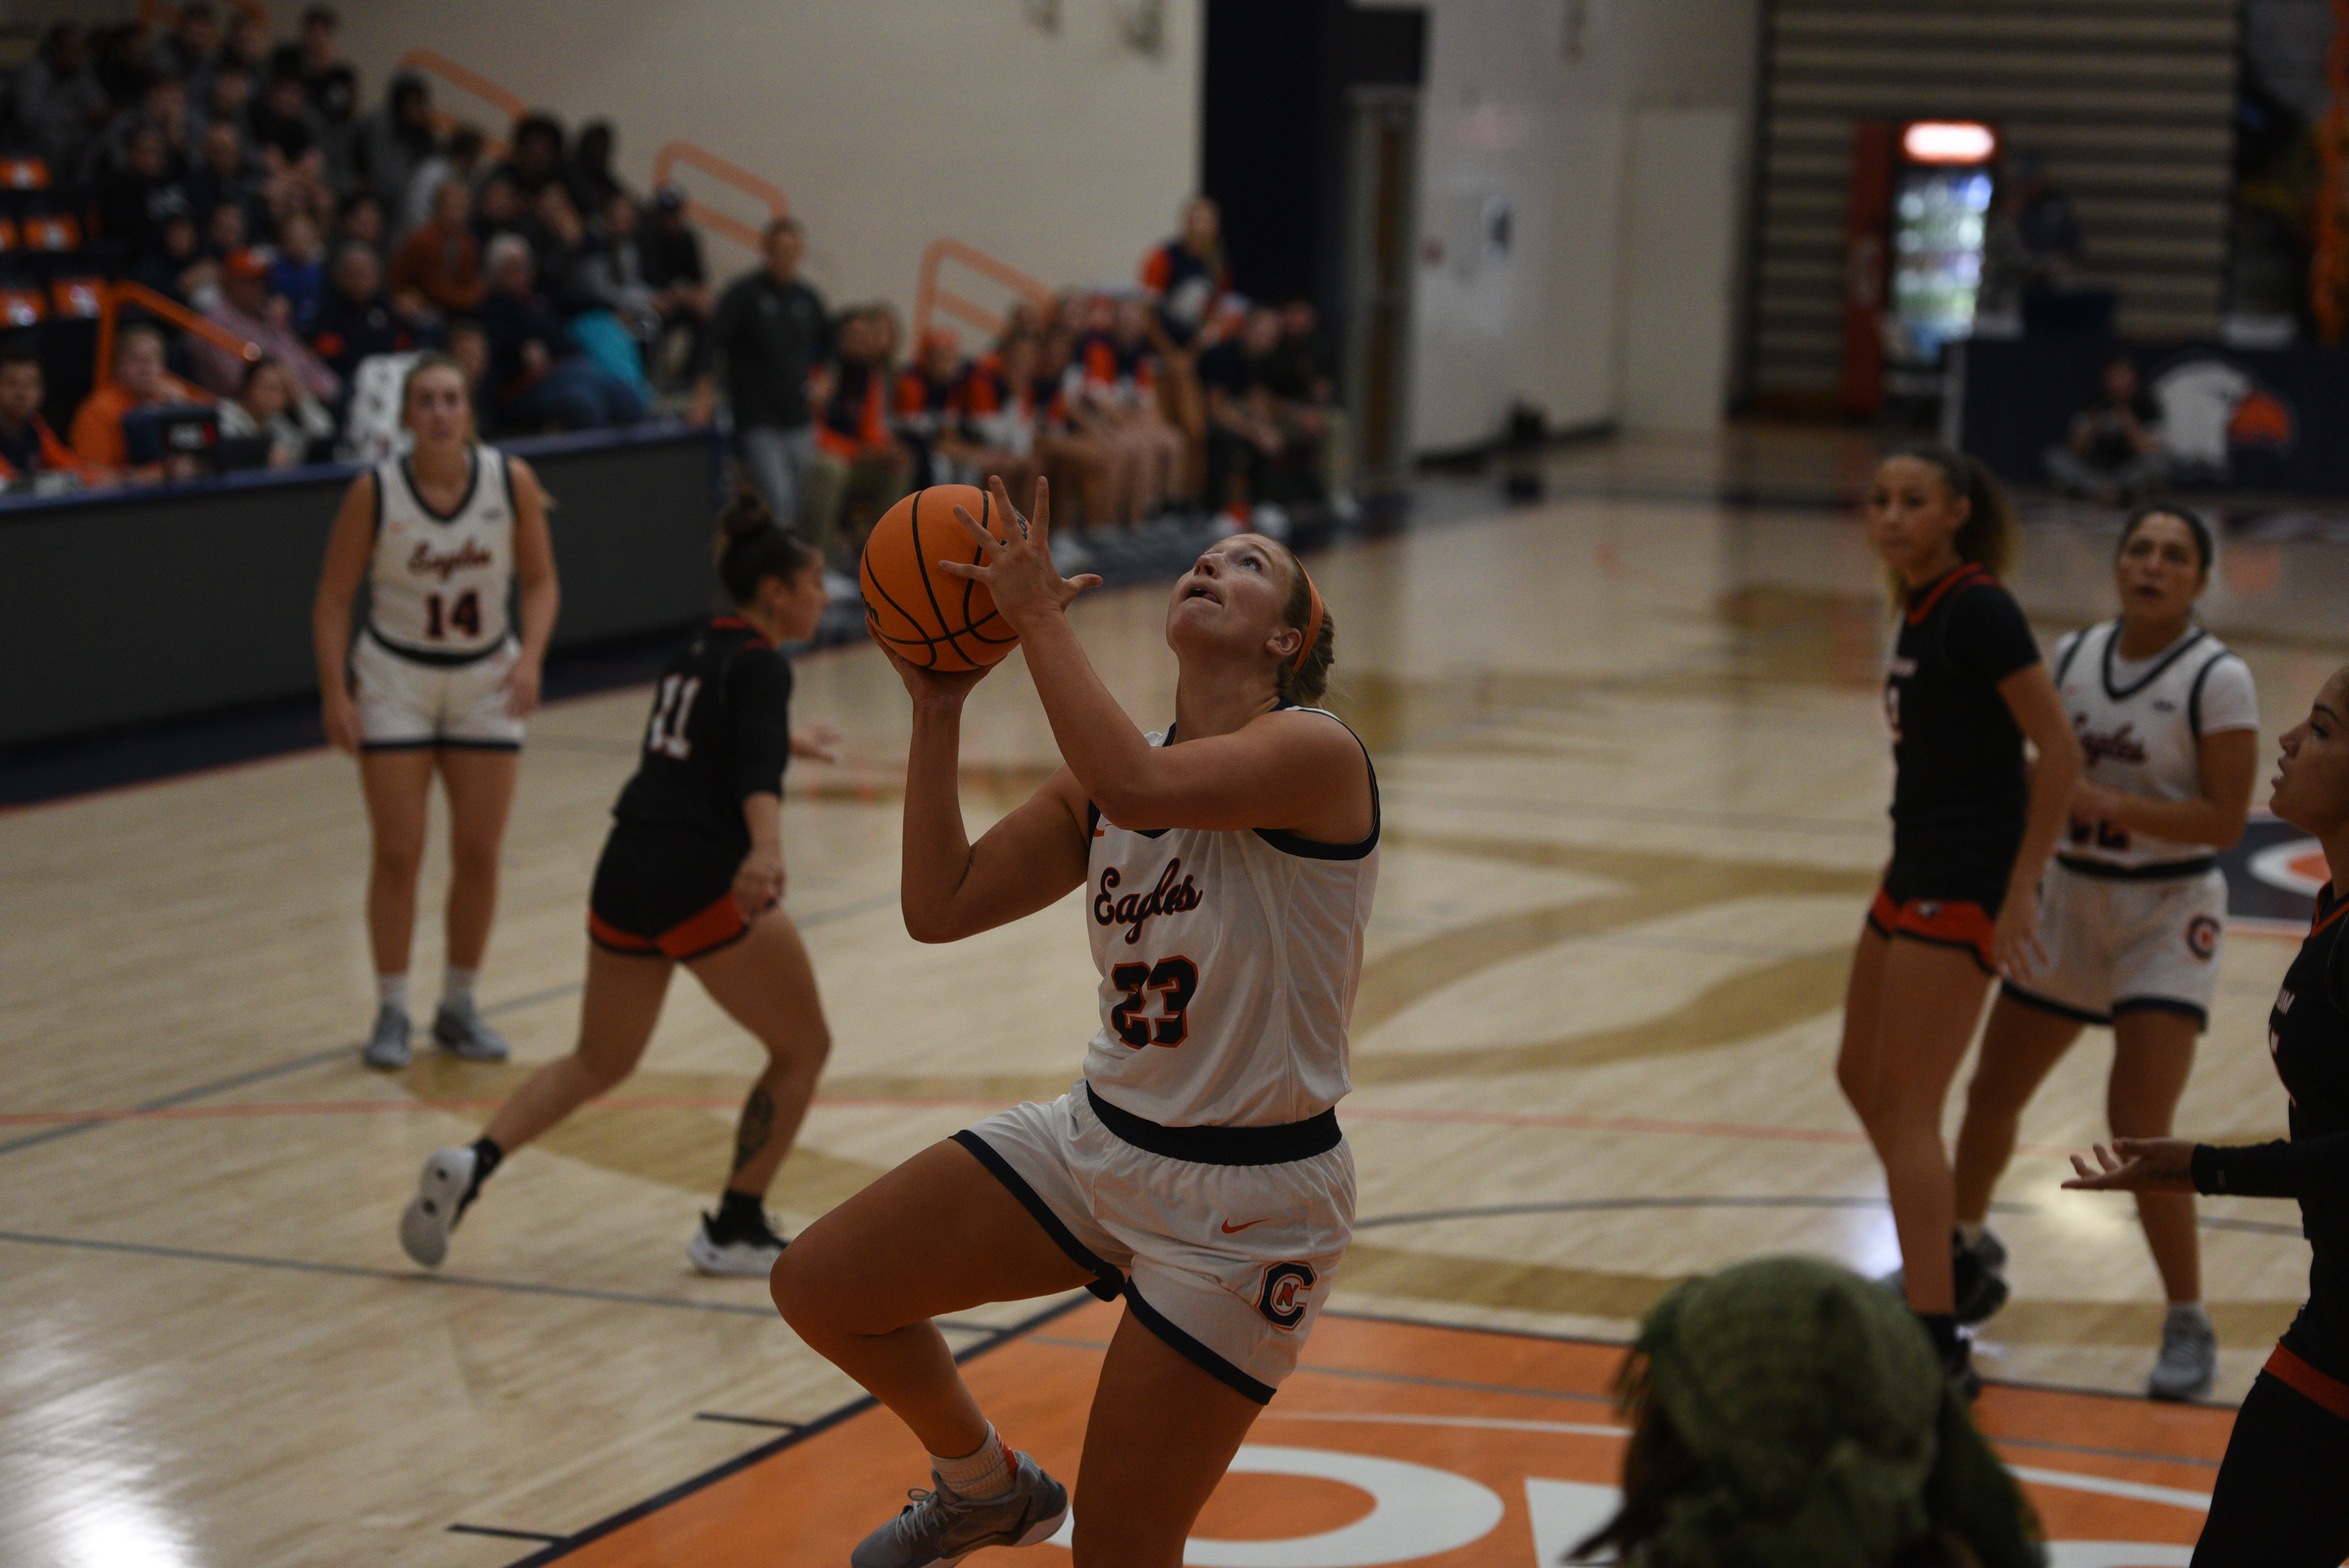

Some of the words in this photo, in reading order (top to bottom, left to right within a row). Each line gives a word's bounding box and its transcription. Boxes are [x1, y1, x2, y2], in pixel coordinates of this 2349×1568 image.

[426, 588, 480, 638] 14
[648, 672, 702, 760] 11
[1094, 857, 1203, 944] Eagles
[1111, 955, 1198, 1050] 23
